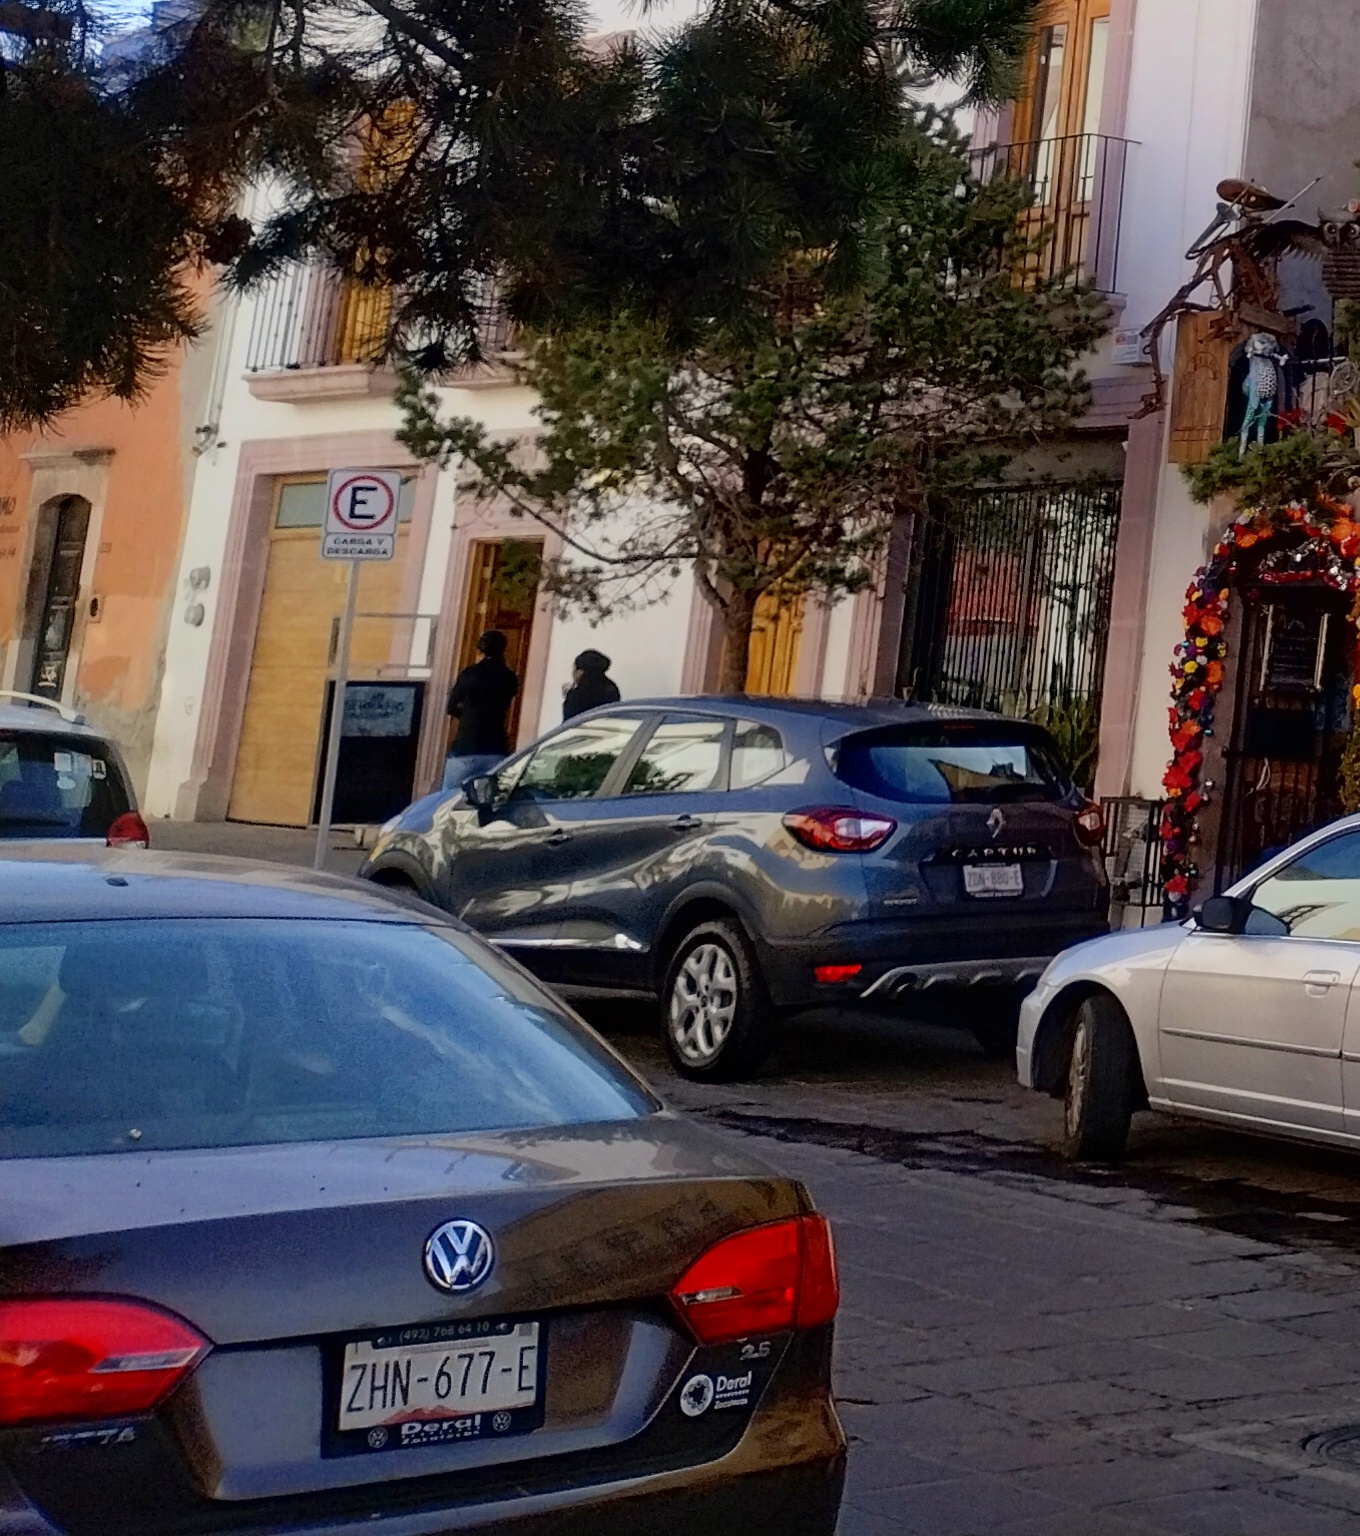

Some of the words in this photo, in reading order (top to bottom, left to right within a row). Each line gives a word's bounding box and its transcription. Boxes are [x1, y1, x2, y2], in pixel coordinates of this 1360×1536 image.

[349, 485, 378, 520] E
[326, 547, 389, 555] DESCARGA
[333, 537, 373, 545] CARGA
[346, 1345, 536, 1413] ZHN-677-E
